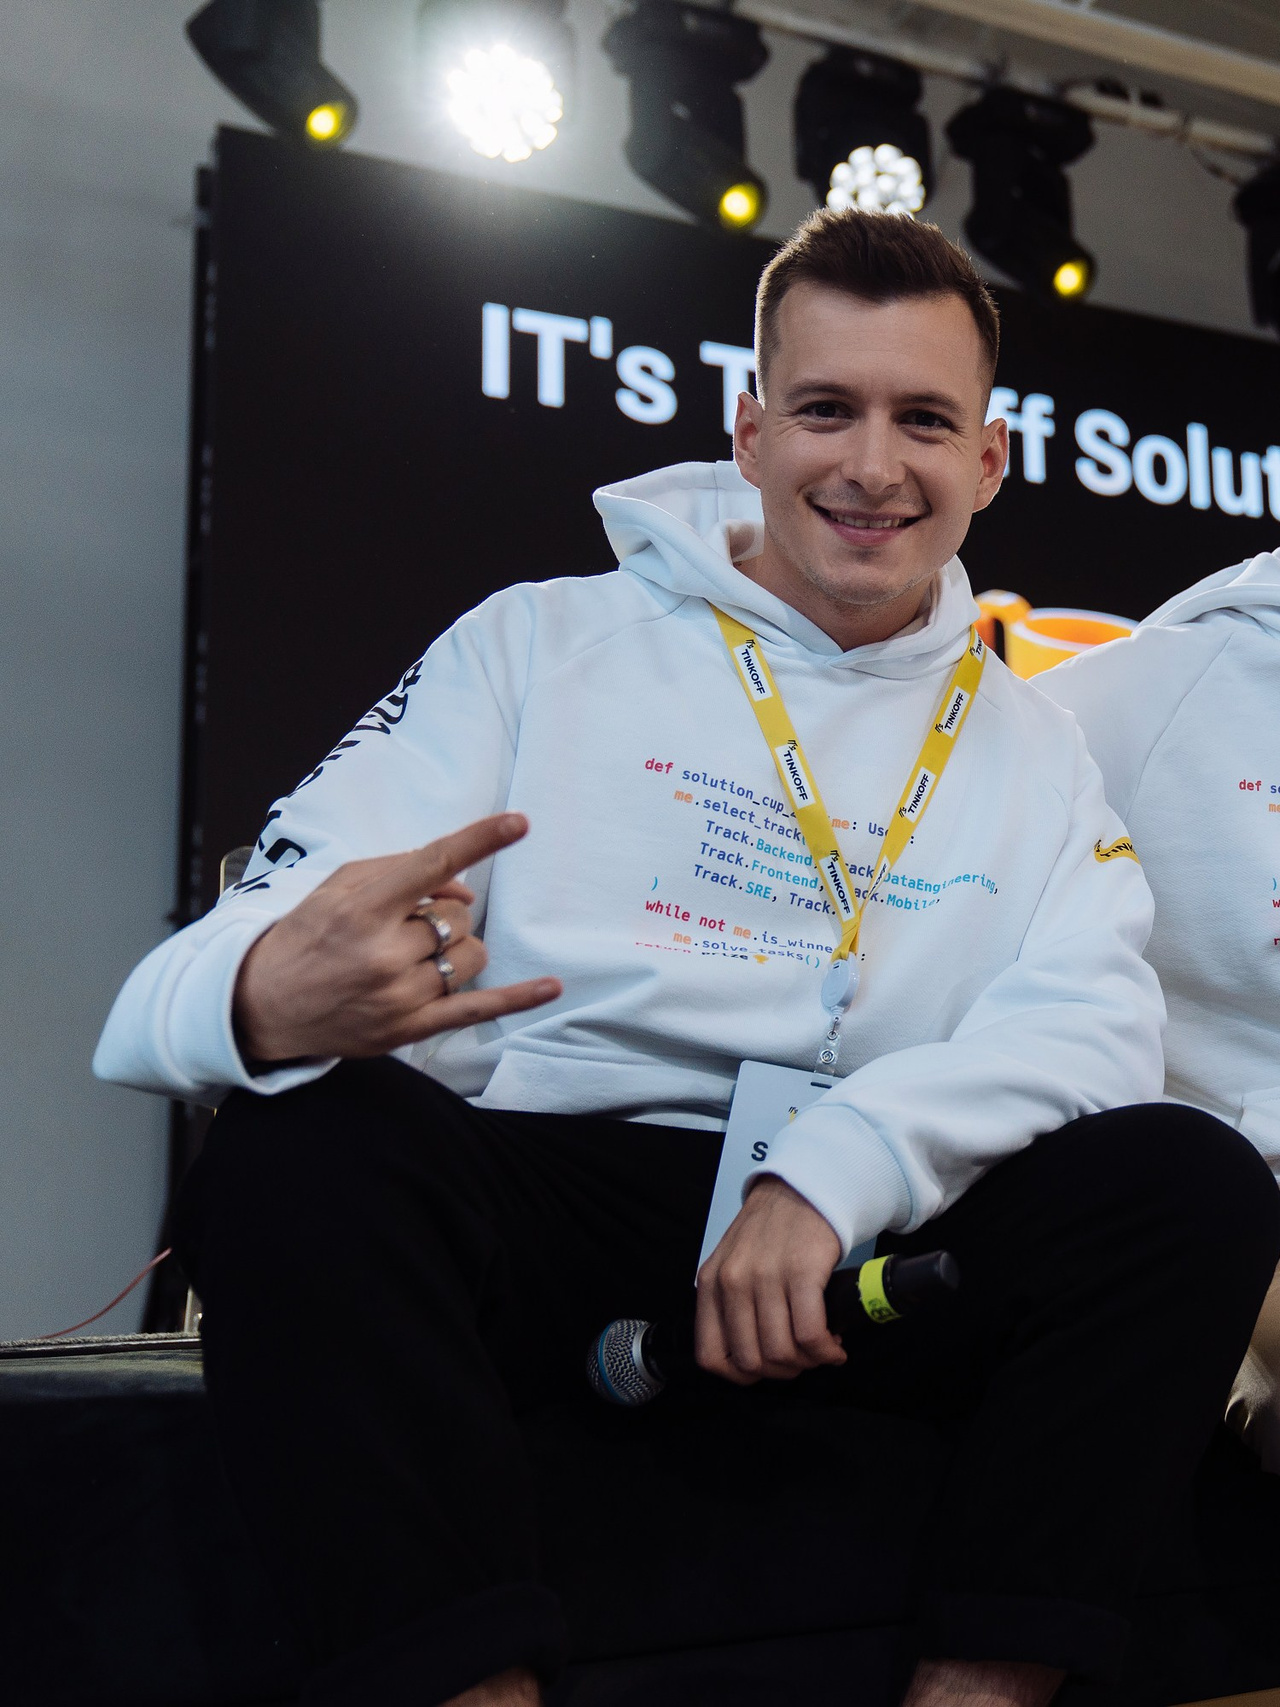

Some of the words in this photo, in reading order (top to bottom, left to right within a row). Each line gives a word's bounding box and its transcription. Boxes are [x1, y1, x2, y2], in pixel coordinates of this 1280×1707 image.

[482, 302, 679, 425] IT's
[741, 649, 766, 695] TINKOFF
[945, 692, 965, 731] TINKOFF
[645, 758, 674, 774] def
[783, 750, 809, 801] TINKOFF
[1238, 779, 1262, 791] def
[907, 773, 931, 815] TINKOFF
[651, 876, 659, 891] )
[700, 841, 824, 892] Track.Frontend,
[1272, 877, 1278, 891] )
[694, 864, 777, 902] Track.SRE,
[789, 892, 836, 915] Track.
[827, 861, 851, 914] TINKOFF
[645, 899, 691, 922] while
[699, 915, 726, 932] not
[672, 931, 821, 969] me.solve_tasks()
